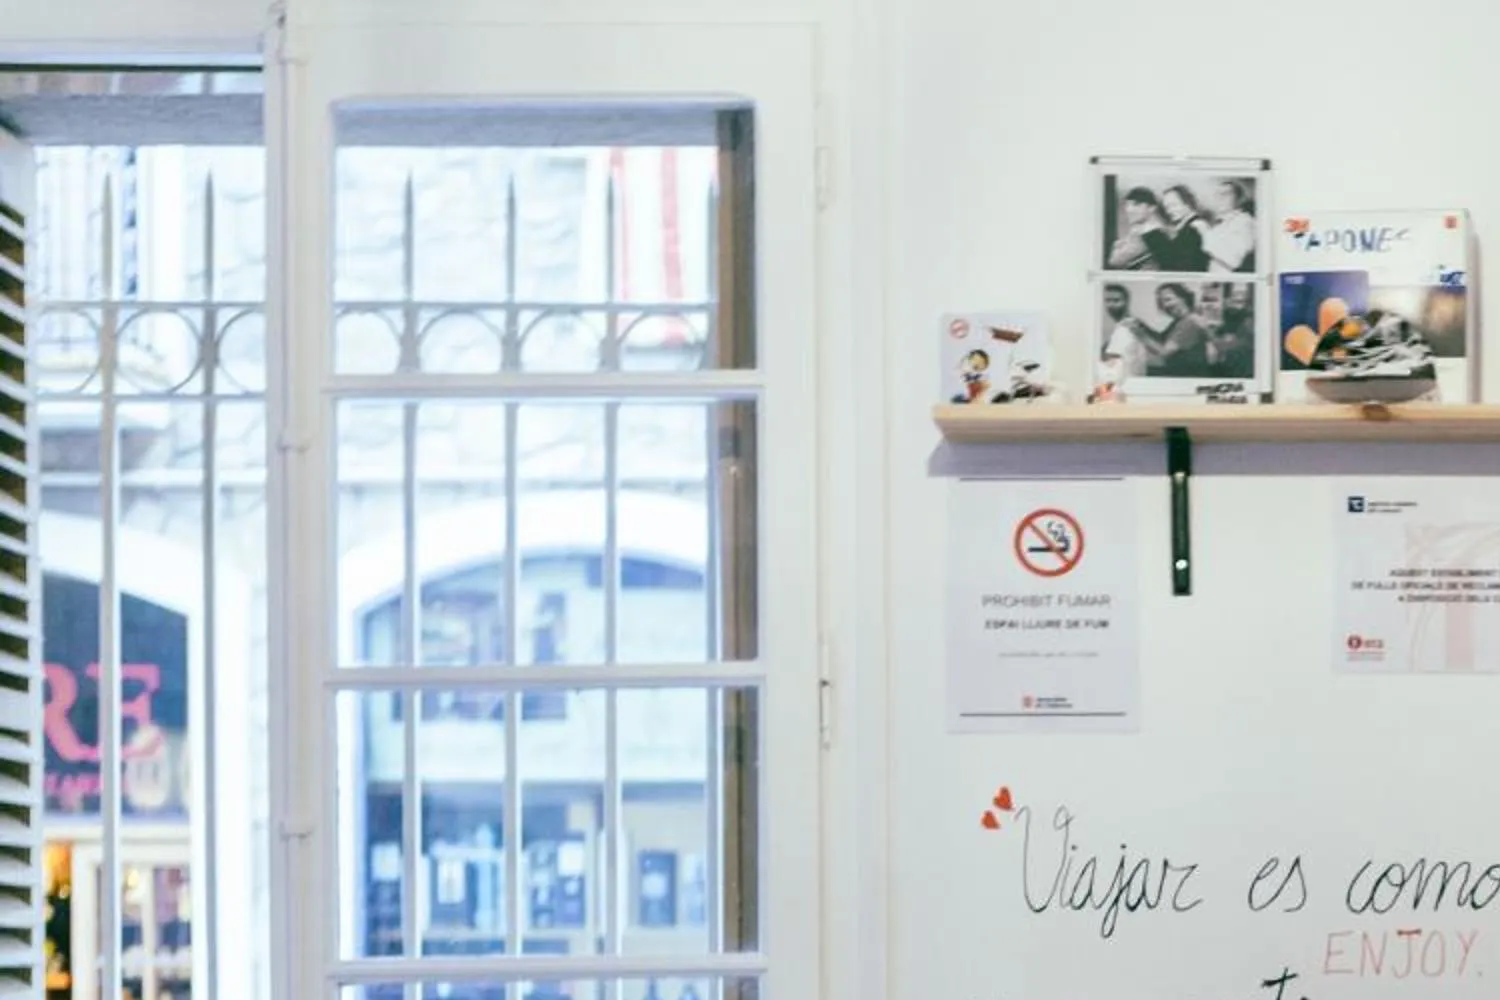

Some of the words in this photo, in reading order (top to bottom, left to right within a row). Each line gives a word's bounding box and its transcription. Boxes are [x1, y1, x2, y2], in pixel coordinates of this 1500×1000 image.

[981, 593, 1054, 608] PROHIBIT
[1013, 804, 1203, 939] Viajar
[1248, 855, 1308, 912] es
